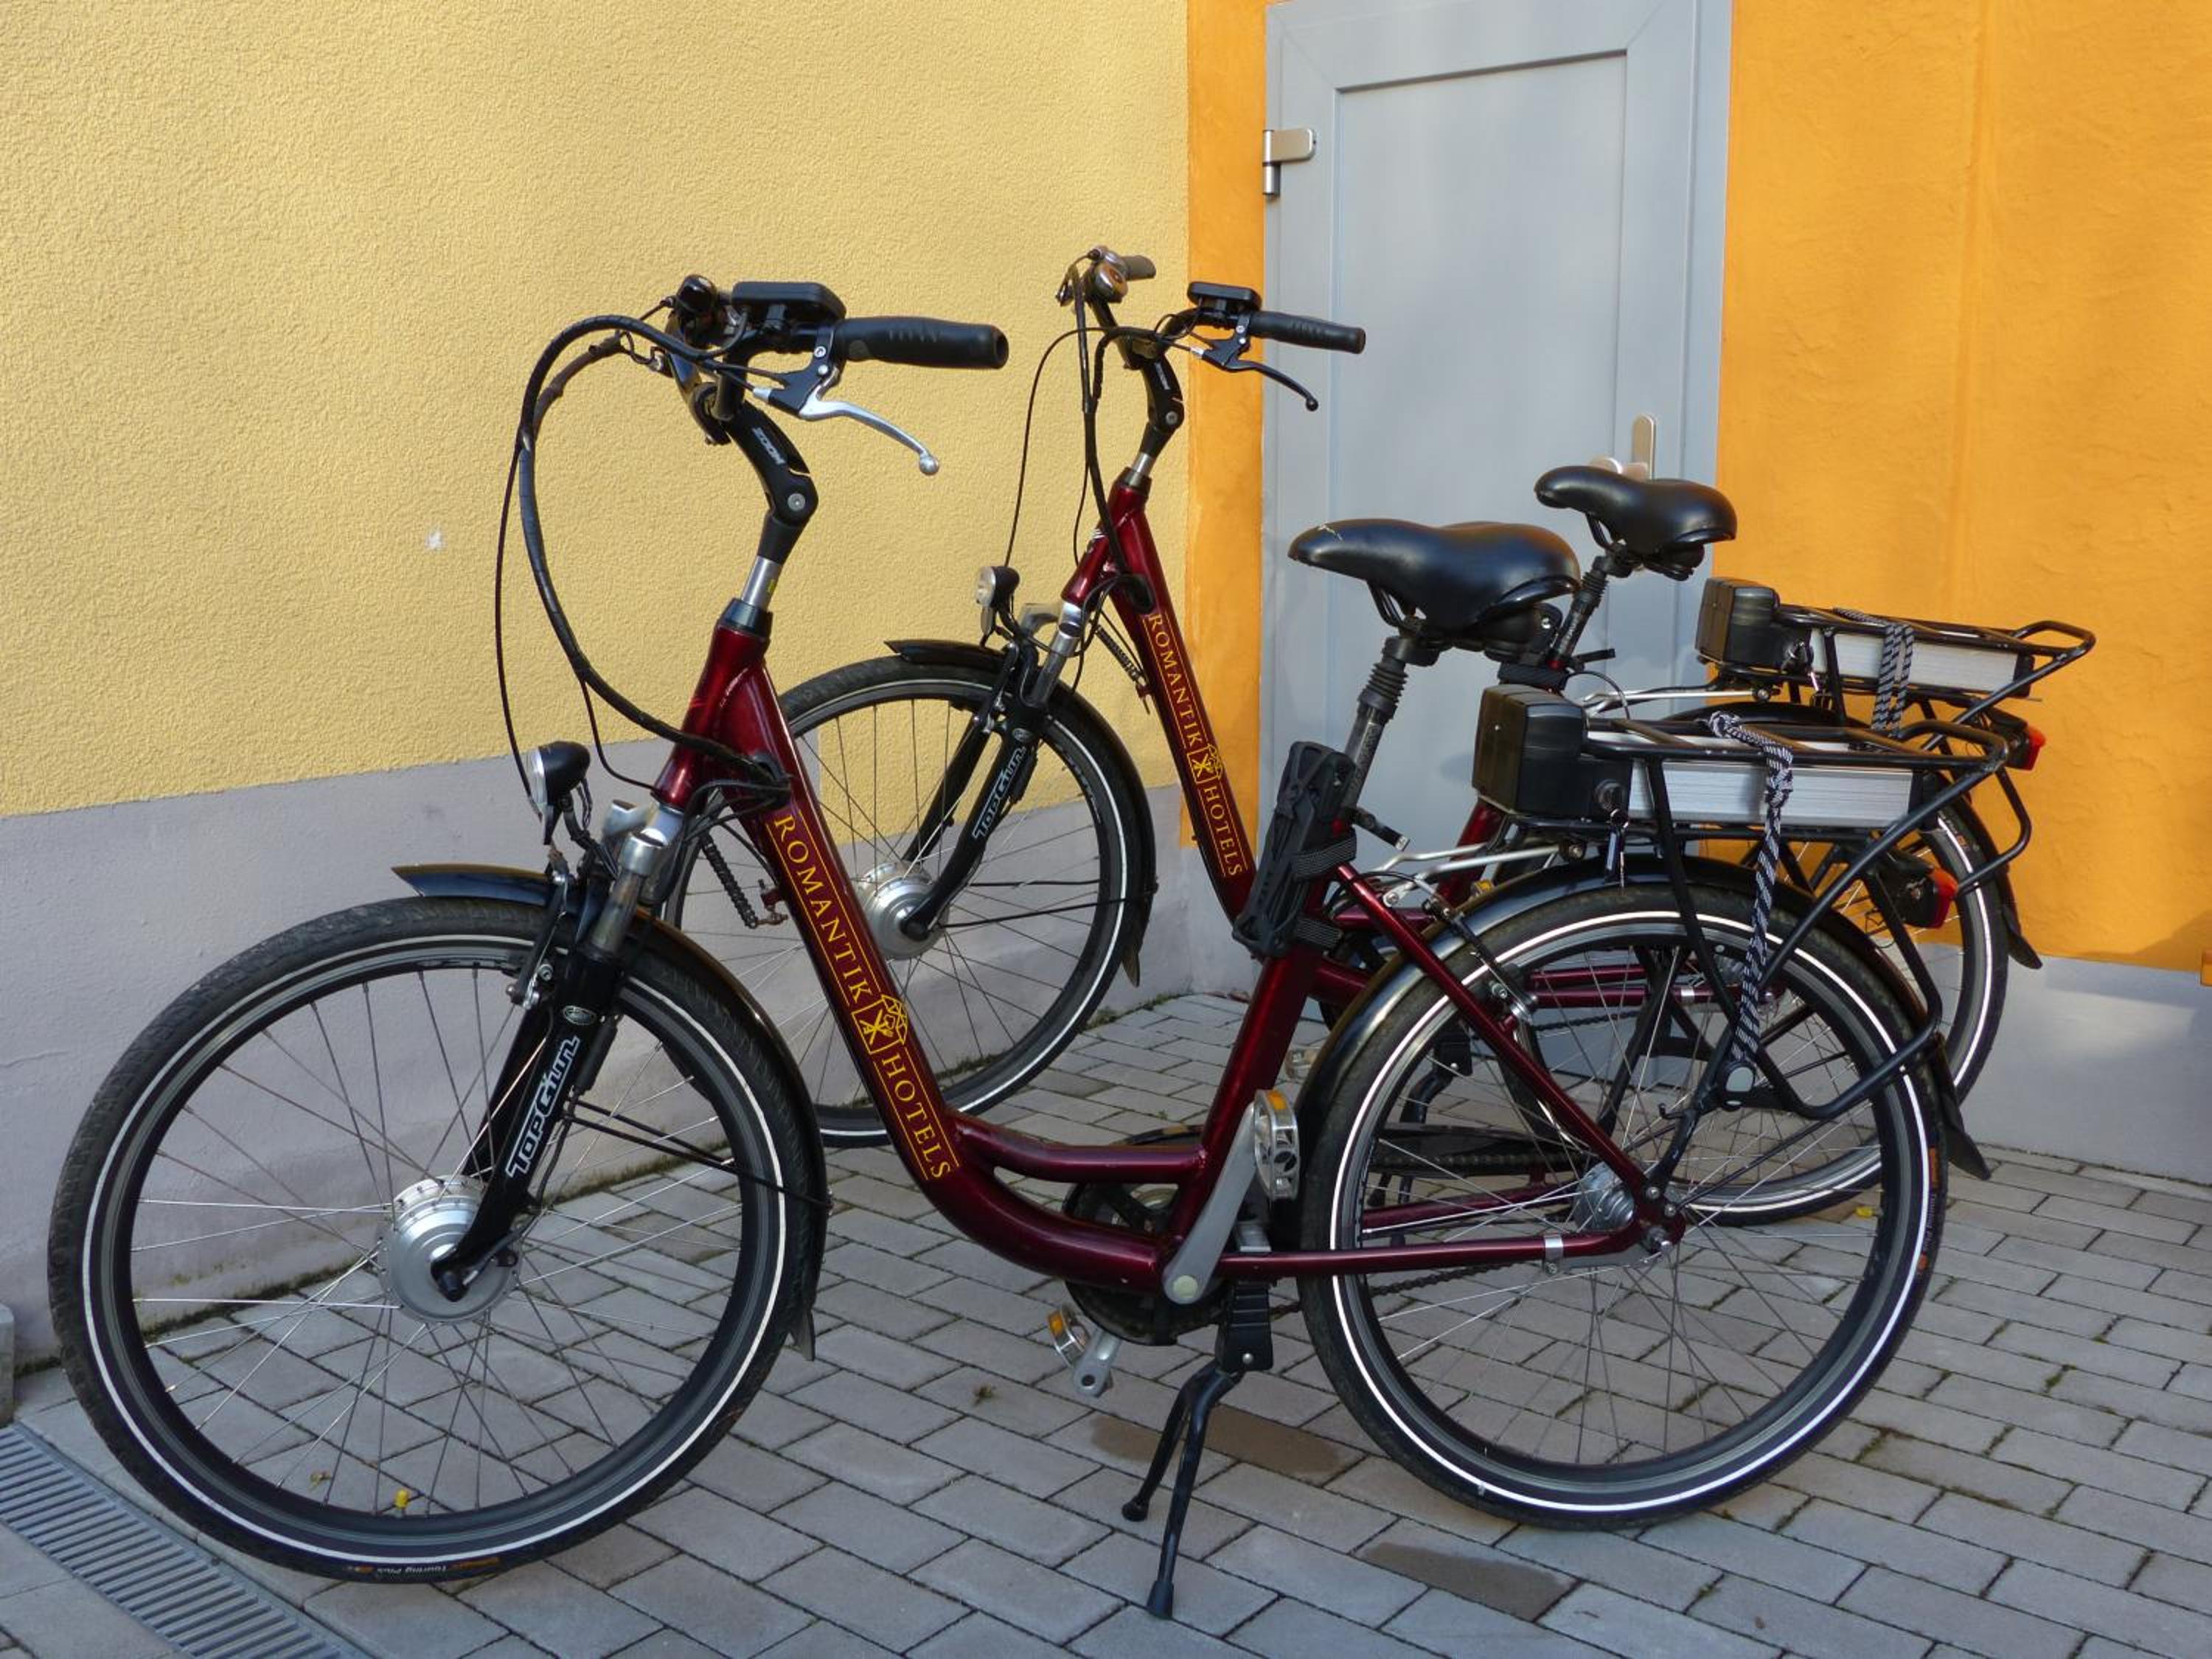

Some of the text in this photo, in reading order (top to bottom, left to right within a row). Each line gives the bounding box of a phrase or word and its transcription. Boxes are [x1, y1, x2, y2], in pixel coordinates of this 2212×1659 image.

[1148, 613, 1242, 877] ROMANTIK HOTELS
[773, 814, 953, 1179] ROMANTIK HOTELS
